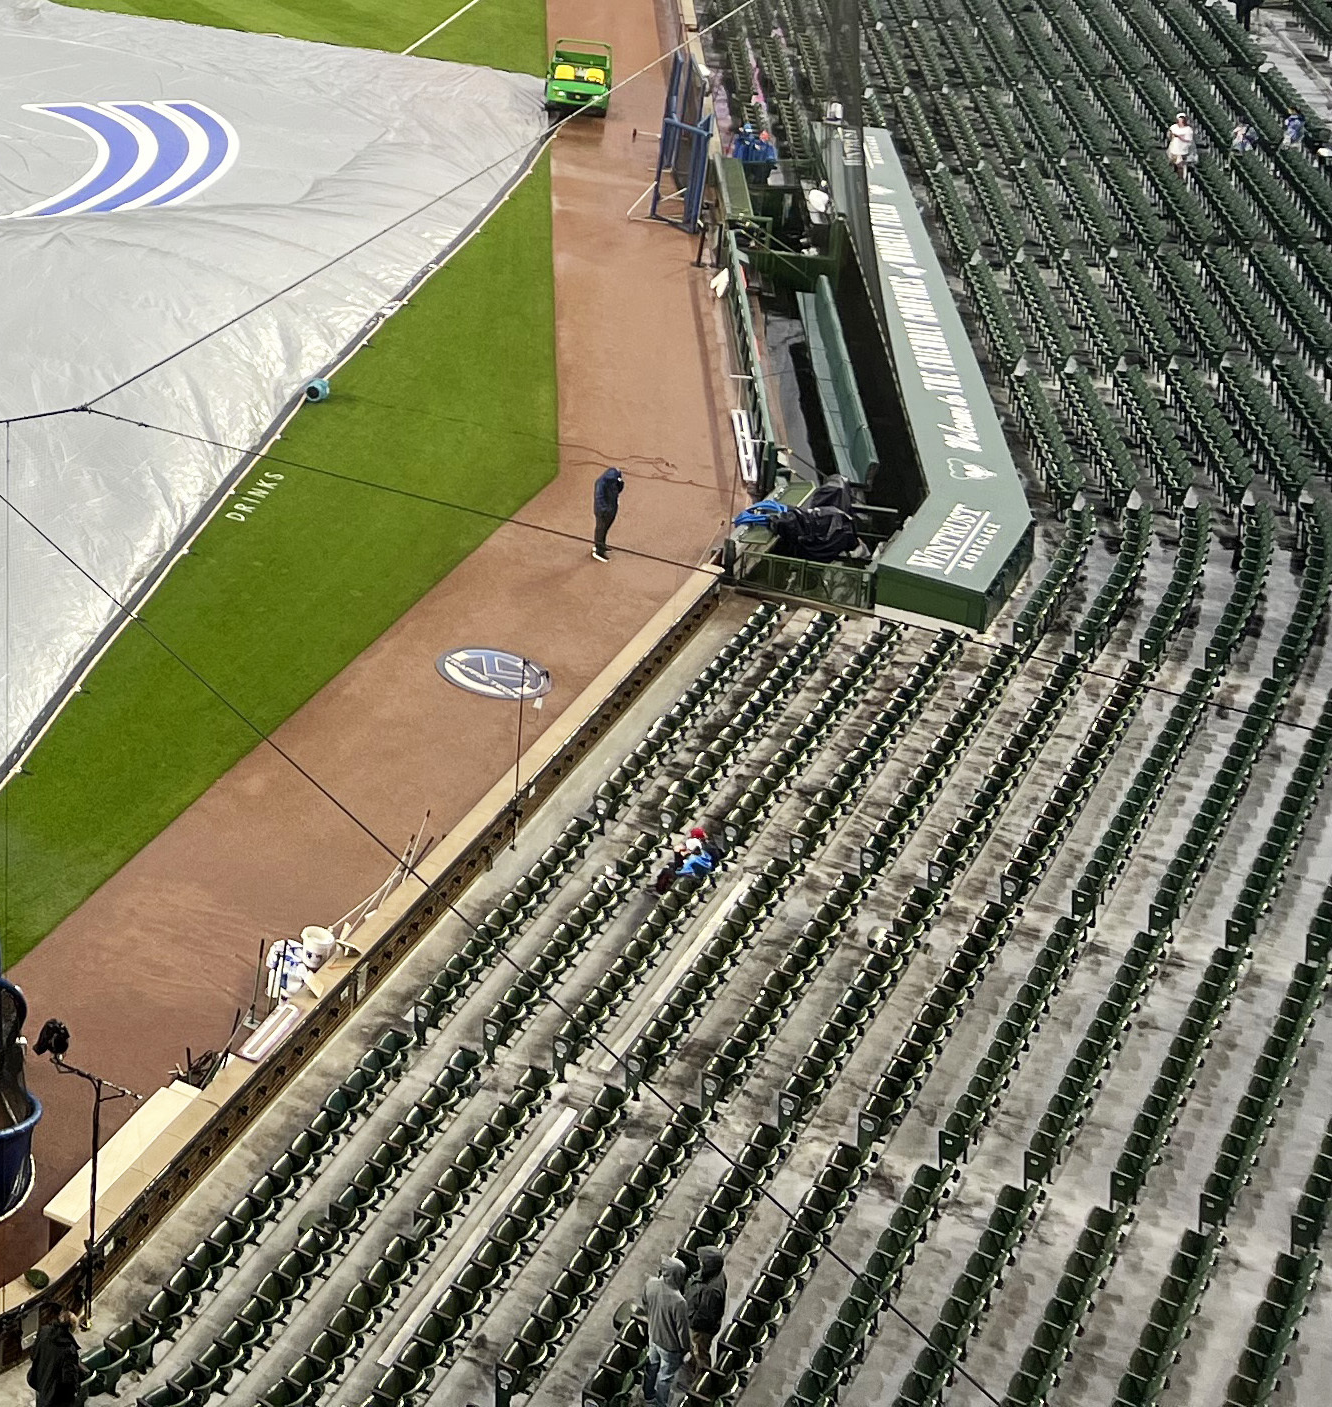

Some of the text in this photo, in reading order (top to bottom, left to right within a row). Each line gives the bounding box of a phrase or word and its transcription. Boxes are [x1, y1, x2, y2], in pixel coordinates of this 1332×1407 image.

[919, 371, 964, 392] THE
[936, 406, 983, 453] Welcome
[225, 468, 285, 523] DRINKS
[906, 502, 984, 571] WINTRUST
